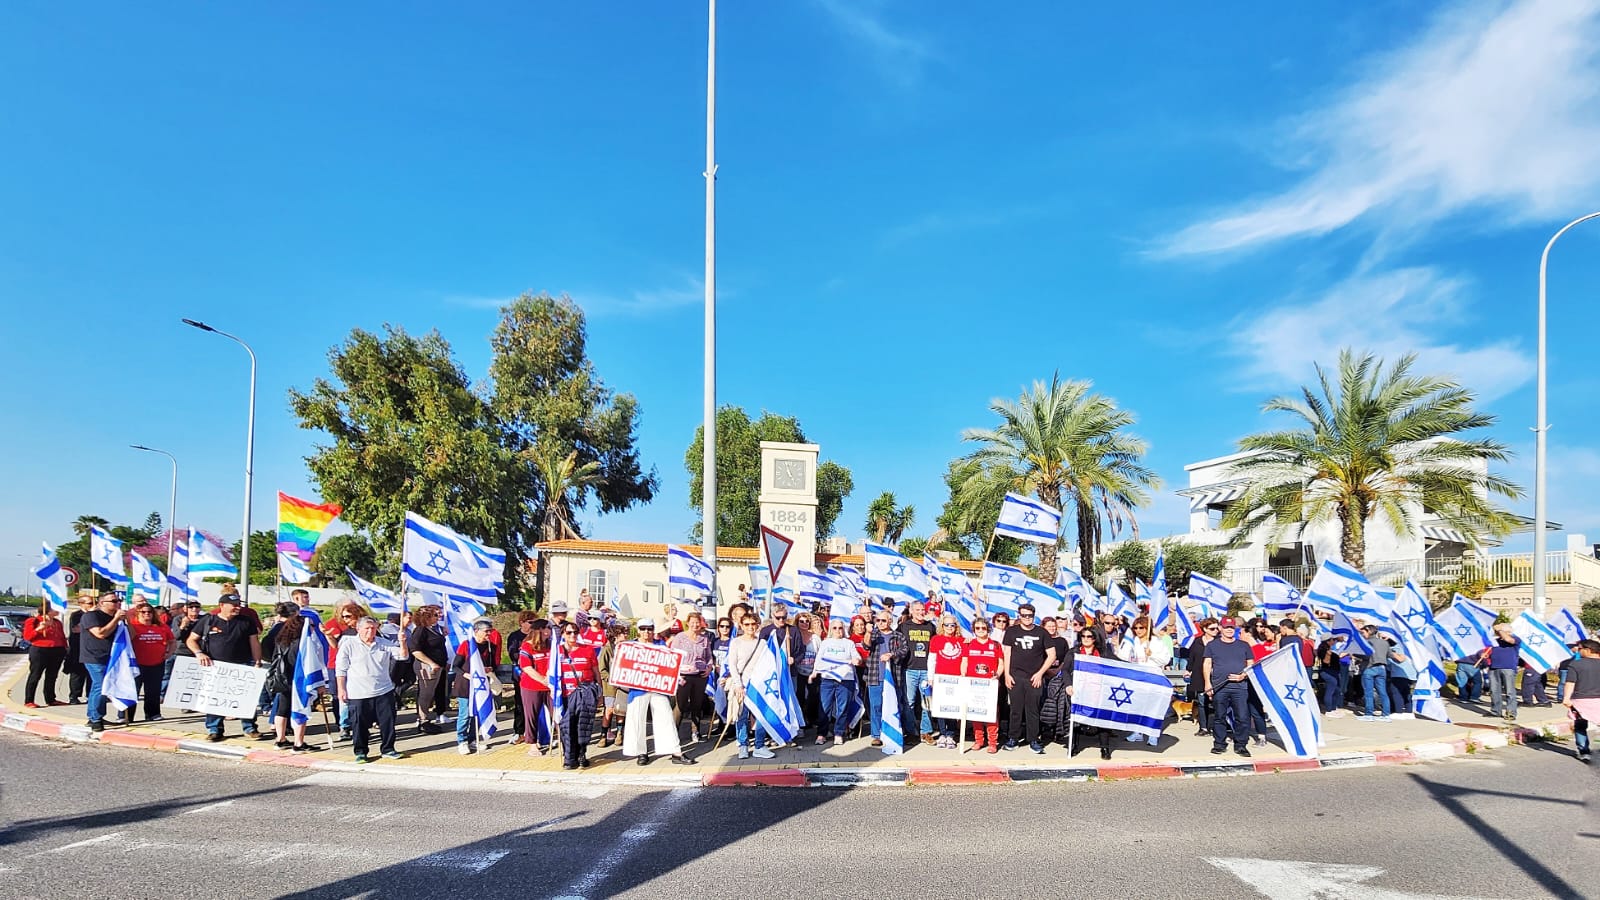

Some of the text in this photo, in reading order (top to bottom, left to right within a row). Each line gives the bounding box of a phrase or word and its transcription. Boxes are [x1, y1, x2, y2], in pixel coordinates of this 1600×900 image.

[770, 510, 807, 524] 1884
[1515, 597, 1553, 605] כמי
[620, 644, 678, 669] PHYSICIANS
[633, 663, 659, 673] FOR
[612, 665, 675, 692] DEMOCRACY
